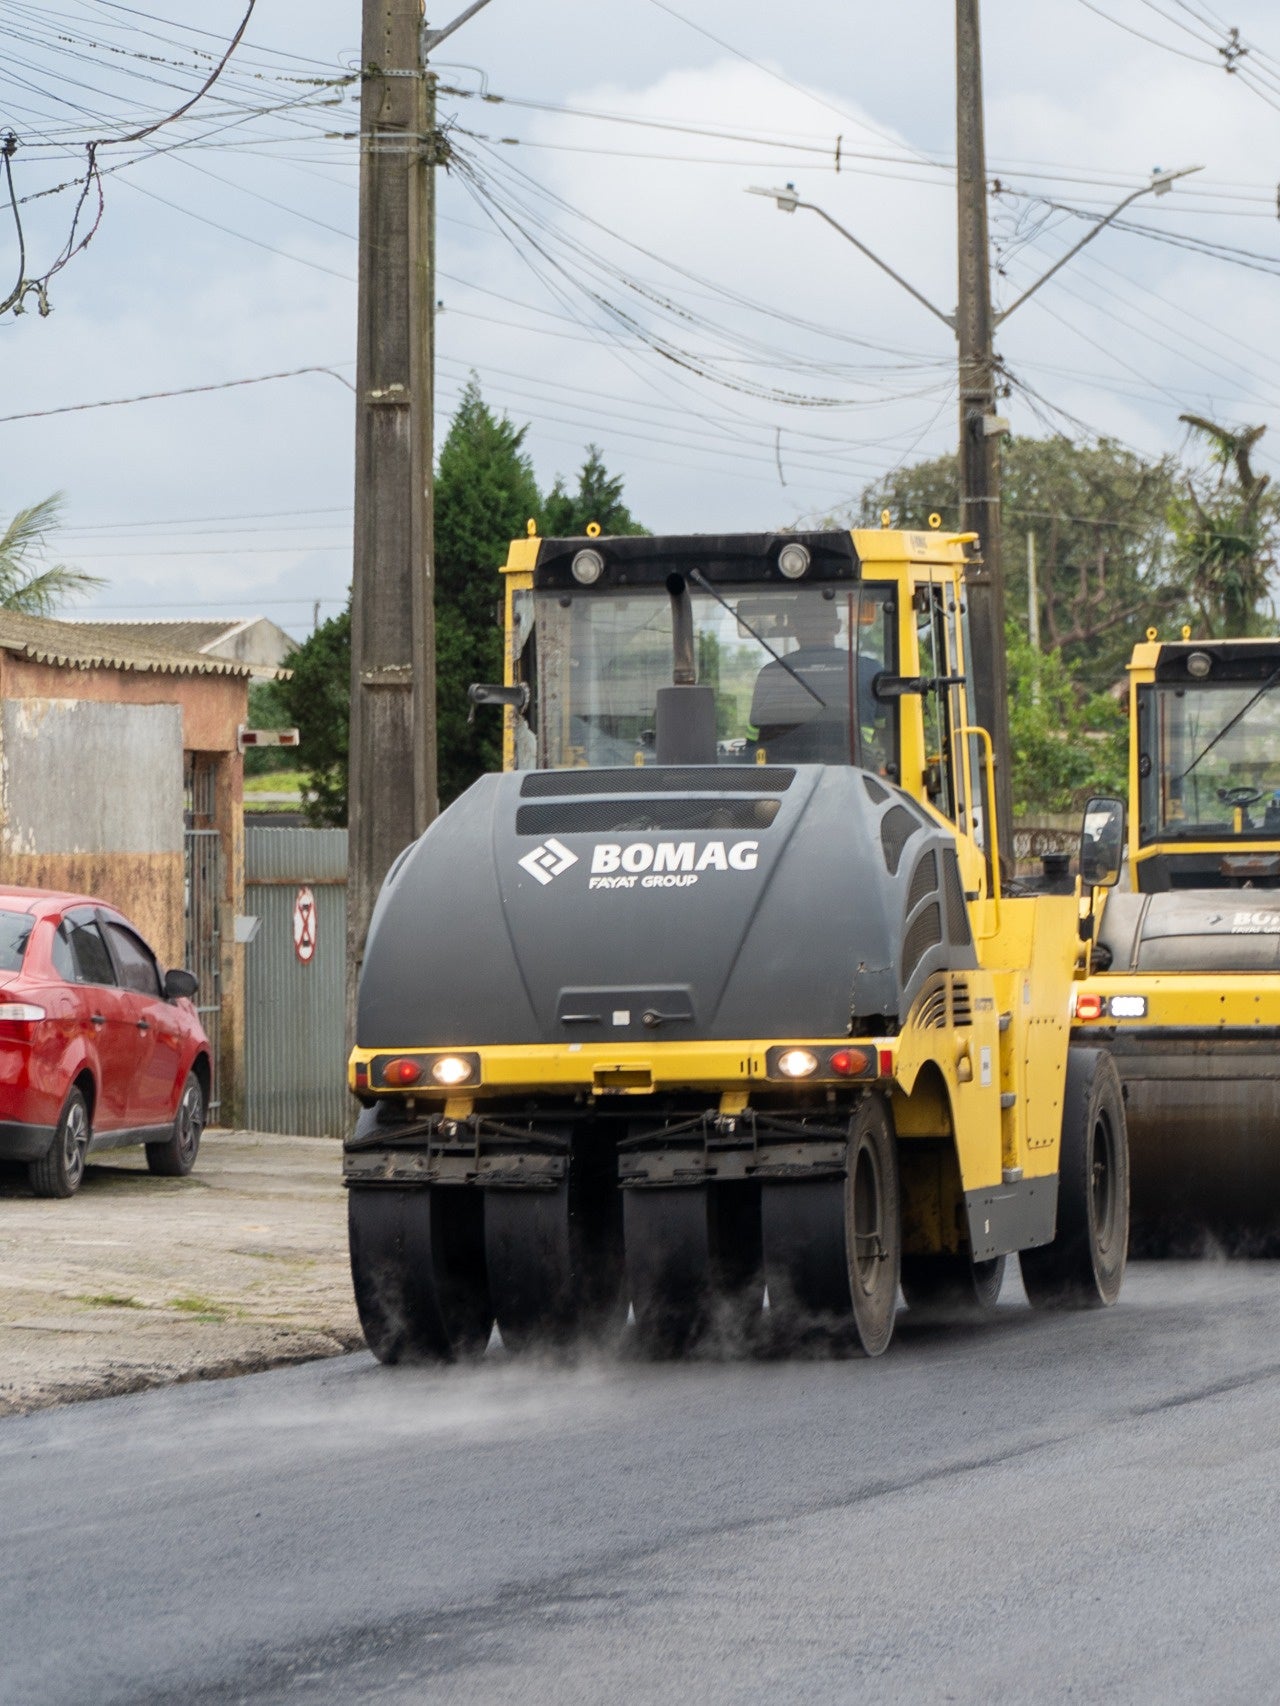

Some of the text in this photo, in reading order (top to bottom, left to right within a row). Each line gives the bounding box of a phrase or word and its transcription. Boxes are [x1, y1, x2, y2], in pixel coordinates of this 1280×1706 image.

[590, 840, 759, 873] BOMAG
[588, 874, 699, 890] FAYAT GROUP
